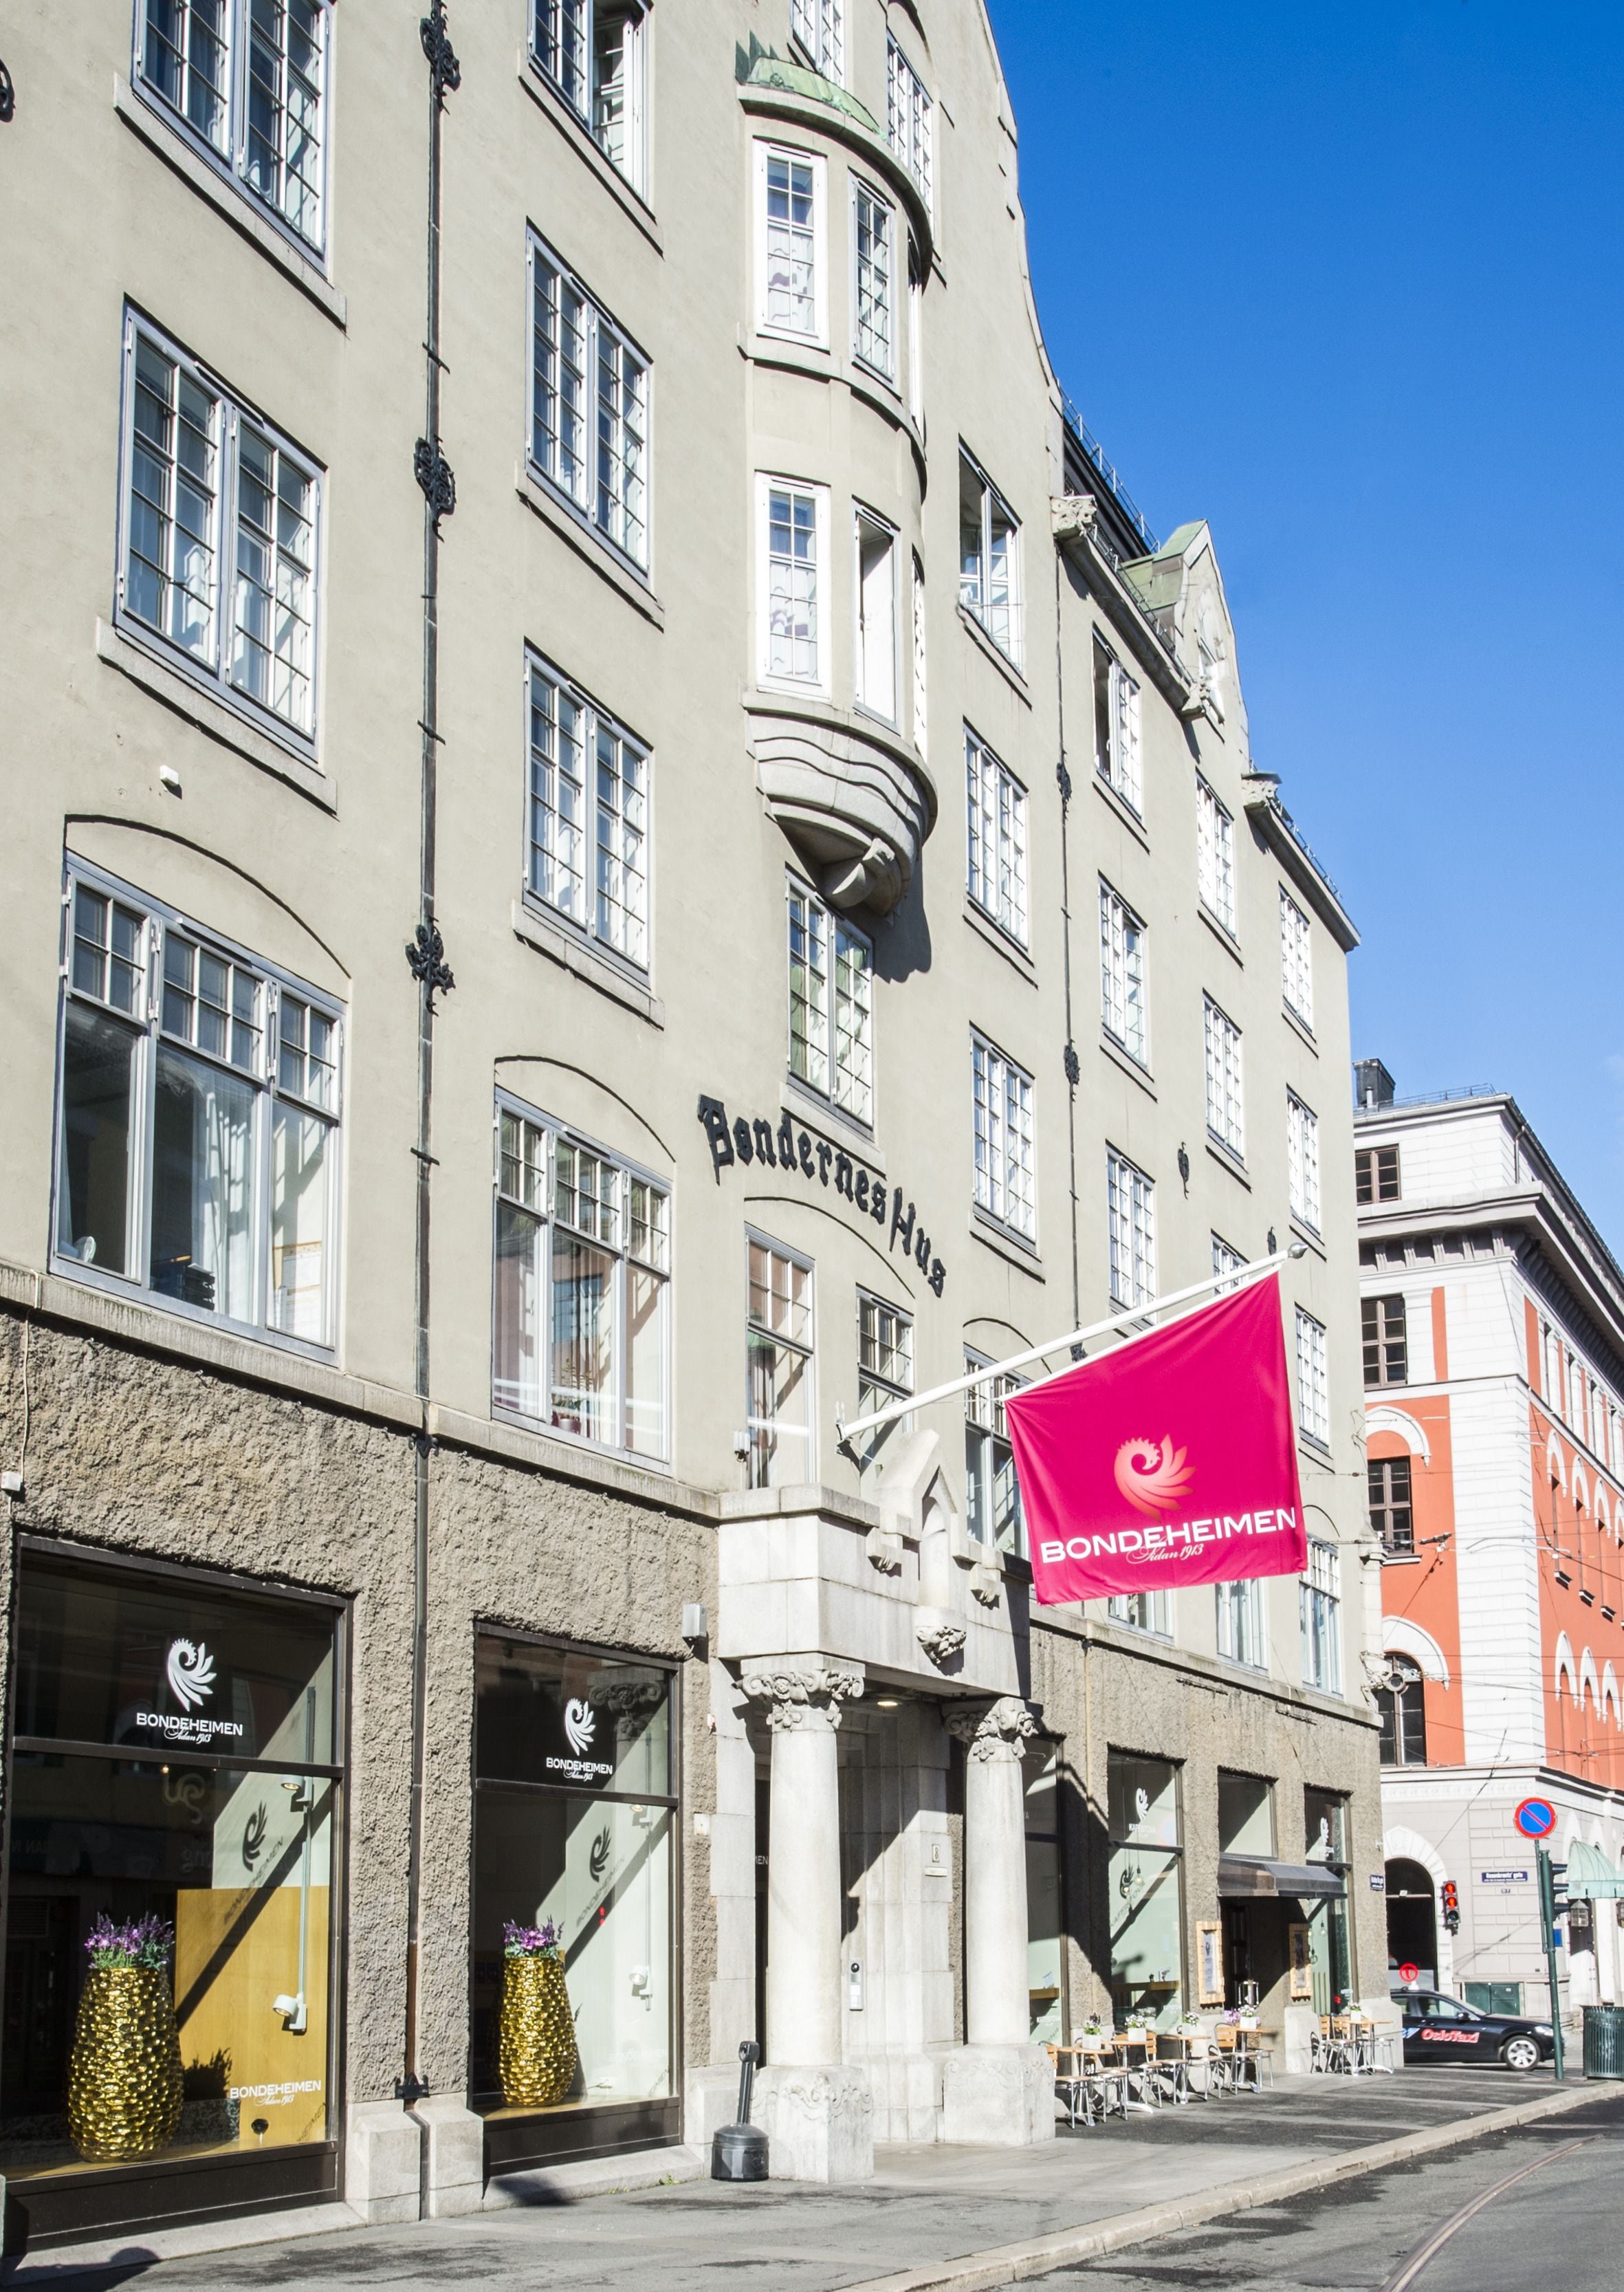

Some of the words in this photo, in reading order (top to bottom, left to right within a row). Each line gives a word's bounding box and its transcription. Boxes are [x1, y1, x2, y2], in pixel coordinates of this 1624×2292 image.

[697, 1094, 887, 1225] Bondernes
[889, 1187, 946, 1298] Hus
[1040, 1507, 1296, 1564] BONDEHEIMEN
[1179, 1542, 1205, 1560] 1913
[136, 1712, 243, 1736] BONDEHEIMEN
[546, 1757, 613, 1774] BONDEHEIMEN
[229, 2079, 322, 2099] BONDEHEIMEN
